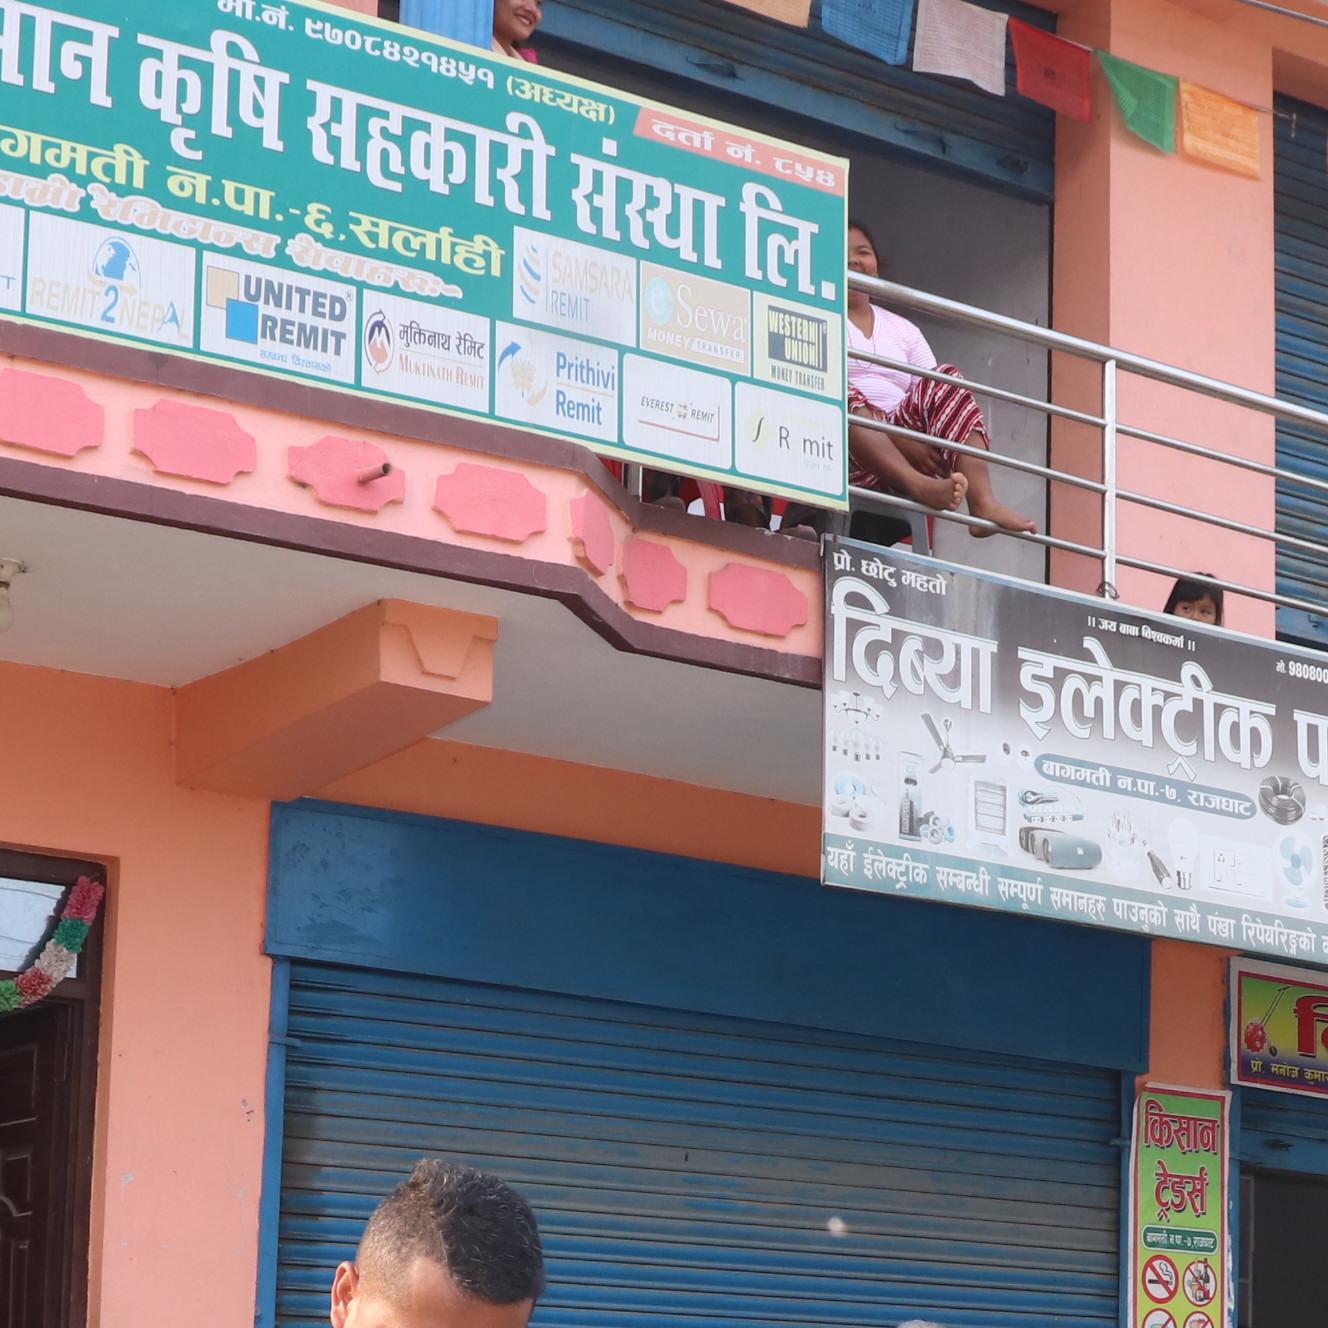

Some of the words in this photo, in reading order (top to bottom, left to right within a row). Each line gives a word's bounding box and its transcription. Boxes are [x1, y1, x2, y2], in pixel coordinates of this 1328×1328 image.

[506, 74, 615, 126] (अध्यक्ष)
[652, 117, 714, 153] दर्ता
[138, 29, 289, 160] कृषि
[306, 79, 556, 221] सहकारी
[570, 137, 725, 270] संस्था
[741, 181, 837, 302] लि.
[552, 251, 635, 303] SAMSARA
[243, 274, 347, 323] UNITED
[551, 289, 591, 323] REMIT
[260, 313, 347, 357] REMIT
[399, 320, 451, 352] मुक्तिनाथ
[456, 331, 485, 359] रेमिट
[647, 327, 691, 350] MONEY
[696, 341, 742, 361] TRANSFER
[769, 309, 819, 344] WESTERN
[556, 351, 616, 392] Prithivi
[784, 338, 819, 369] UNION
[771, 364, 793, 384] MONEY
[795, 369, 826, 392] TRANSFER
[556, 390, 602, 426] Remit
[640, 396, 674, 414] EVEREST
[690, 408, 715, 424] REMIT
[833, 549, 855, 572] प्रो.
[860, 557, 898, 588] छोटु
[902, 569, 948, 596] महतो
[1098, 617, 1118, 633] जय
[1017, 635, 1277, 782] इलेक्ट्रीक
[1041, 758, 1113, 788] बागमती
[1187, 788, 1253, 818] राजघाट
[826, 838, 856, 878] यहाँ
[936, 864, 991, 898] सम्बन्धी
[997, 876, 1044, 912] सम्पूर्ण
[1112, 895, 1167, 932] पाउनुको
[1173, 902, 1201, 935] साथै
[1207, 911, 1236, 942] पंखा
[1249, 1057, 1266, 1075] प्रो.
[1270, 1060, 1300, 1080] मनोज
[1142, 1098, 1220, 1155] किसान
[1153, 1159, 1210, 1222] ट्रेडर्स
